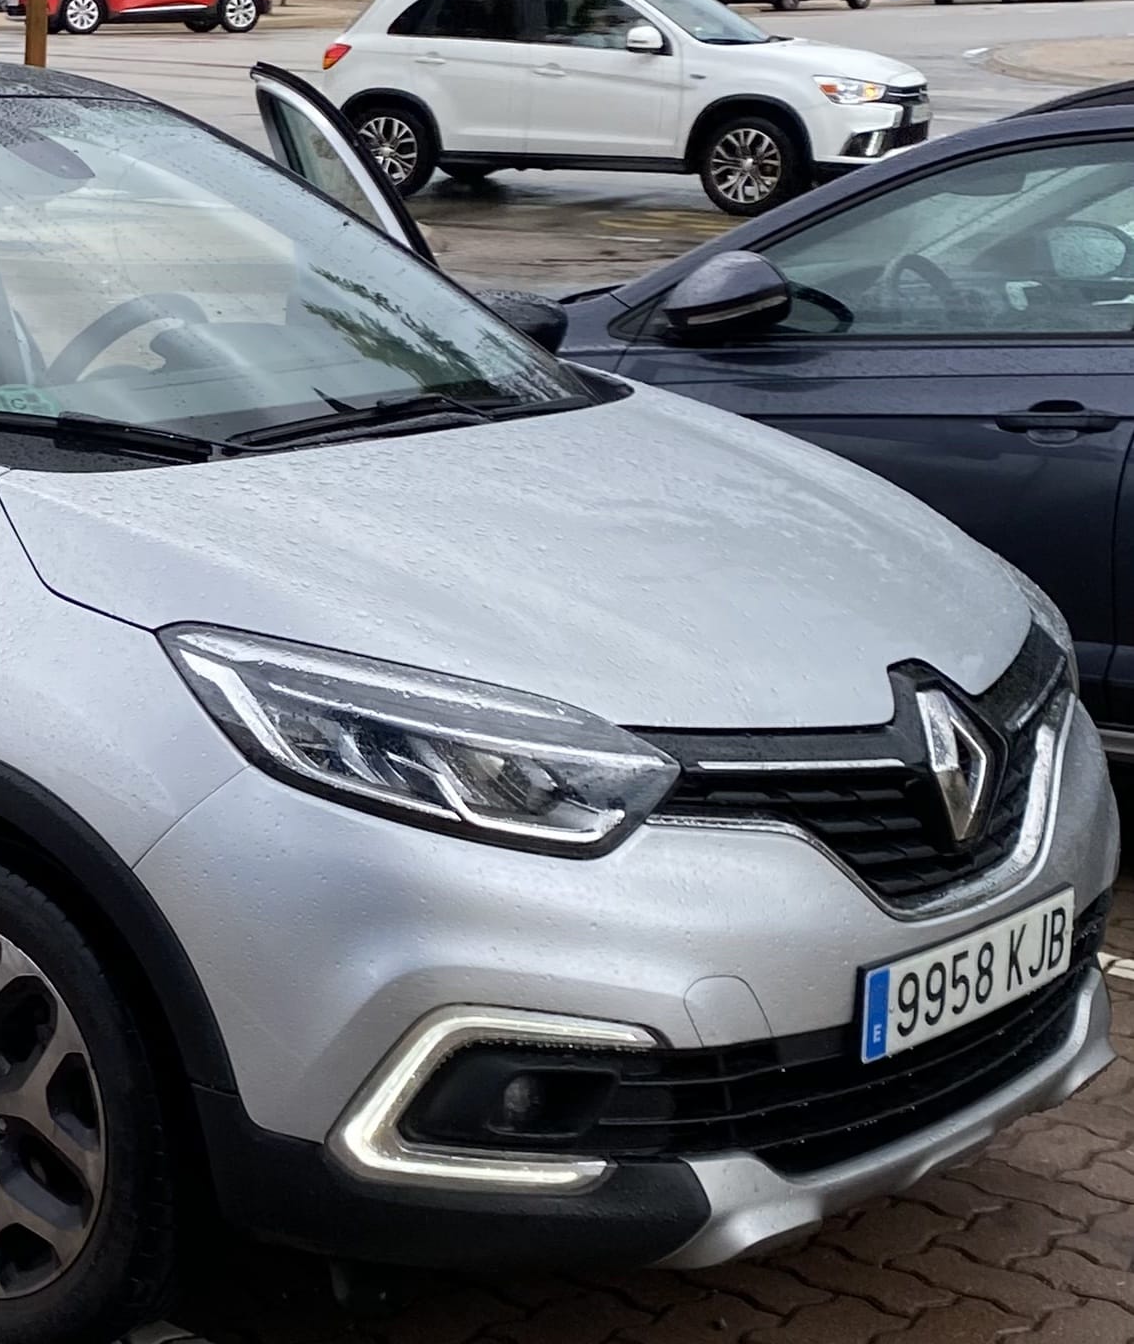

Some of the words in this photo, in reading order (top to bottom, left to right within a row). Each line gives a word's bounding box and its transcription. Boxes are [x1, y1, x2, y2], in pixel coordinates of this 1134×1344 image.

[897, 941, 994, 1037] 9958
[1006, 906, 1066, 992] KJB
[872, 1023, 883, 1044] E
